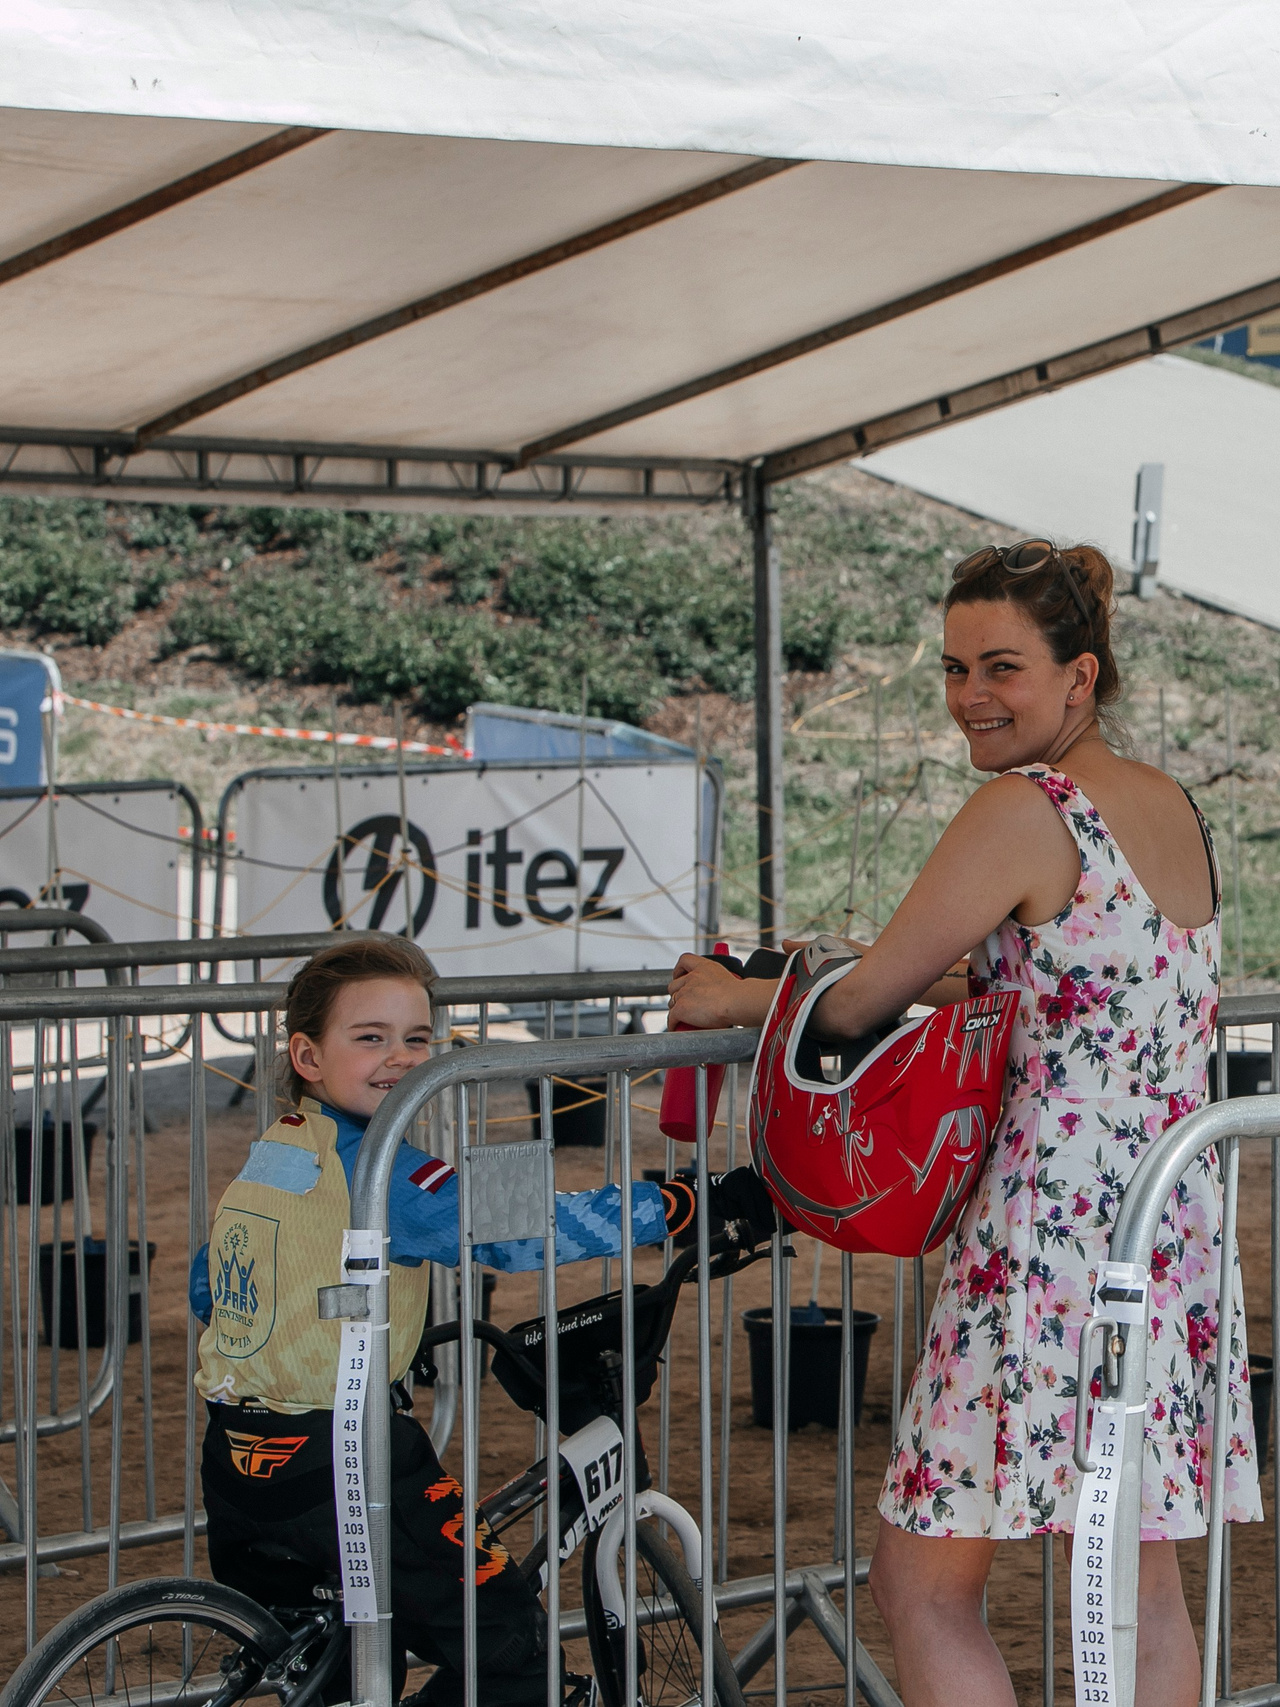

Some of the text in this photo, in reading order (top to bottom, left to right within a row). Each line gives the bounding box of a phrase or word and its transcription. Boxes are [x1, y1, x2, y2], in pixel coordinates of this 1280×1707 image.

[465, 828, 625, 930] itez
[359, 1340, 365, 1351] 3
[350, 1358, 364, 1370] 13
[347, 1379, 361, 1390] 23
[345, 1399, 359, 1411] 33
[344, 1420, 357, 1432] 43
[1108, 1422, 1115, 1436] 2
[344, 1441, 357, 1452] 53
[1101, 1443, 1114, 1457] 12
[345, 1457, 358, 1468] 63
[346, 1473, 359, 1485] 73
[583, 1442, 623, 1504] 617
[1097, 1466, 1112, 1480] 22
[347, 1489, 360, 1501] 83
[1092, 1489, 1108, 1503] 32
[349, 1506, 362, 1517] 93
[1089, 1513, 1105, 1527] 42
[344, 1523, 364, 1535] 103
[346, 1542, 366, 1553] 113
[1087, 1536, 1103, 1551] 52
[347, 1559, 368, 1571] 123
[1087, 1555, 1103, 1569] 62
[350, 1576, 370, 1588] 133
[1086, 1574, 1103, 1588] 72
[1087, 1592, 1103, 1606] 82
[1087, 1611, 1104, 1624] 92
[1080, 1630, 1105, 1645] 102
[1081, 1651, 1107, 1665] 112
[1083, 1670, 1108, 1684] 122
[1084, 1688, 1109, 1703] 132
